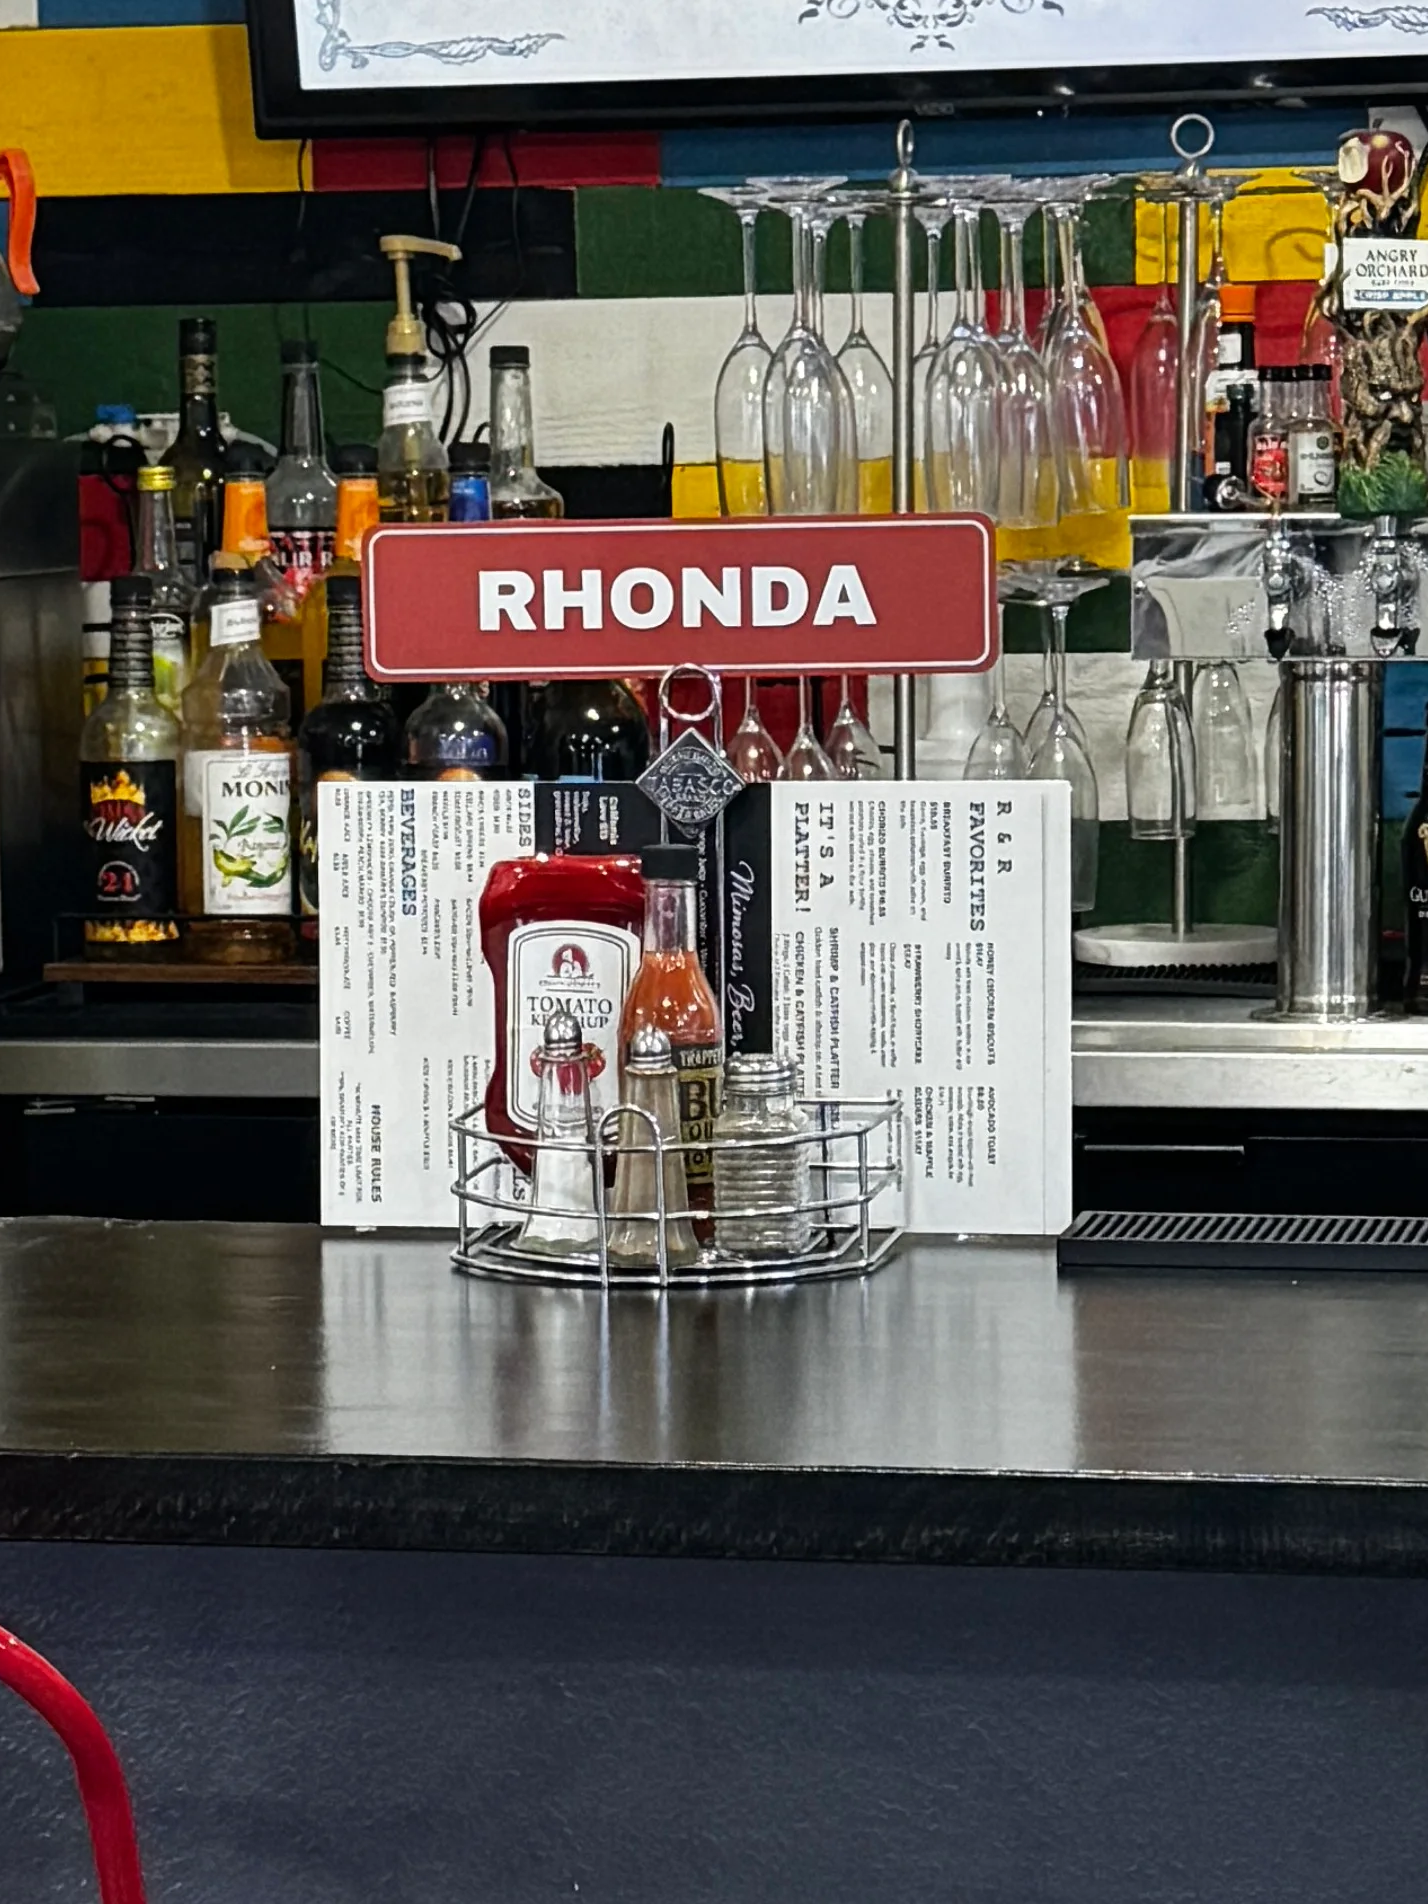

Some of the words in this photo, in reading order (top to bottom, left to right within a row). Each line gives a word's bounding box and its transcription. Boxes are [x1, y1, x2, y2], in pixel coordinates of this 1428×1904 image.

[1366, 249, 1418, 262] ANGRY
[478, 564, 877, 631] RHONDA
[518, 788, 532, 848] SIDES
[819, 802, 835, 859] IT'S
[997, 801, 1012, 816] R
[400, 788, 417, 916] BEVERAGES
[794, 802, 811, 913] PLATTER!
[969, 802, 985, 932] FAVORITES
[997, 859, 1012, 874] R
[101, 871, 134, 893] 21
[819, 872, 835, 889] A
[730, 861, 755, 977] Mimosas,
[795, 932, 805, 985] CHICKEN
[527, 996, 613, 1015] TOMATO
[728, 983, 755, 1047] Beer,
[795, 1000, 805, 1050] CATFISH
[830, 987, 839, 1035] CATFISH
[830, 1038, 839, 1089] PLATTER
[371, 1104, 381, 1153] HOUSE
[371, 1157, 382, 1203] RULES
